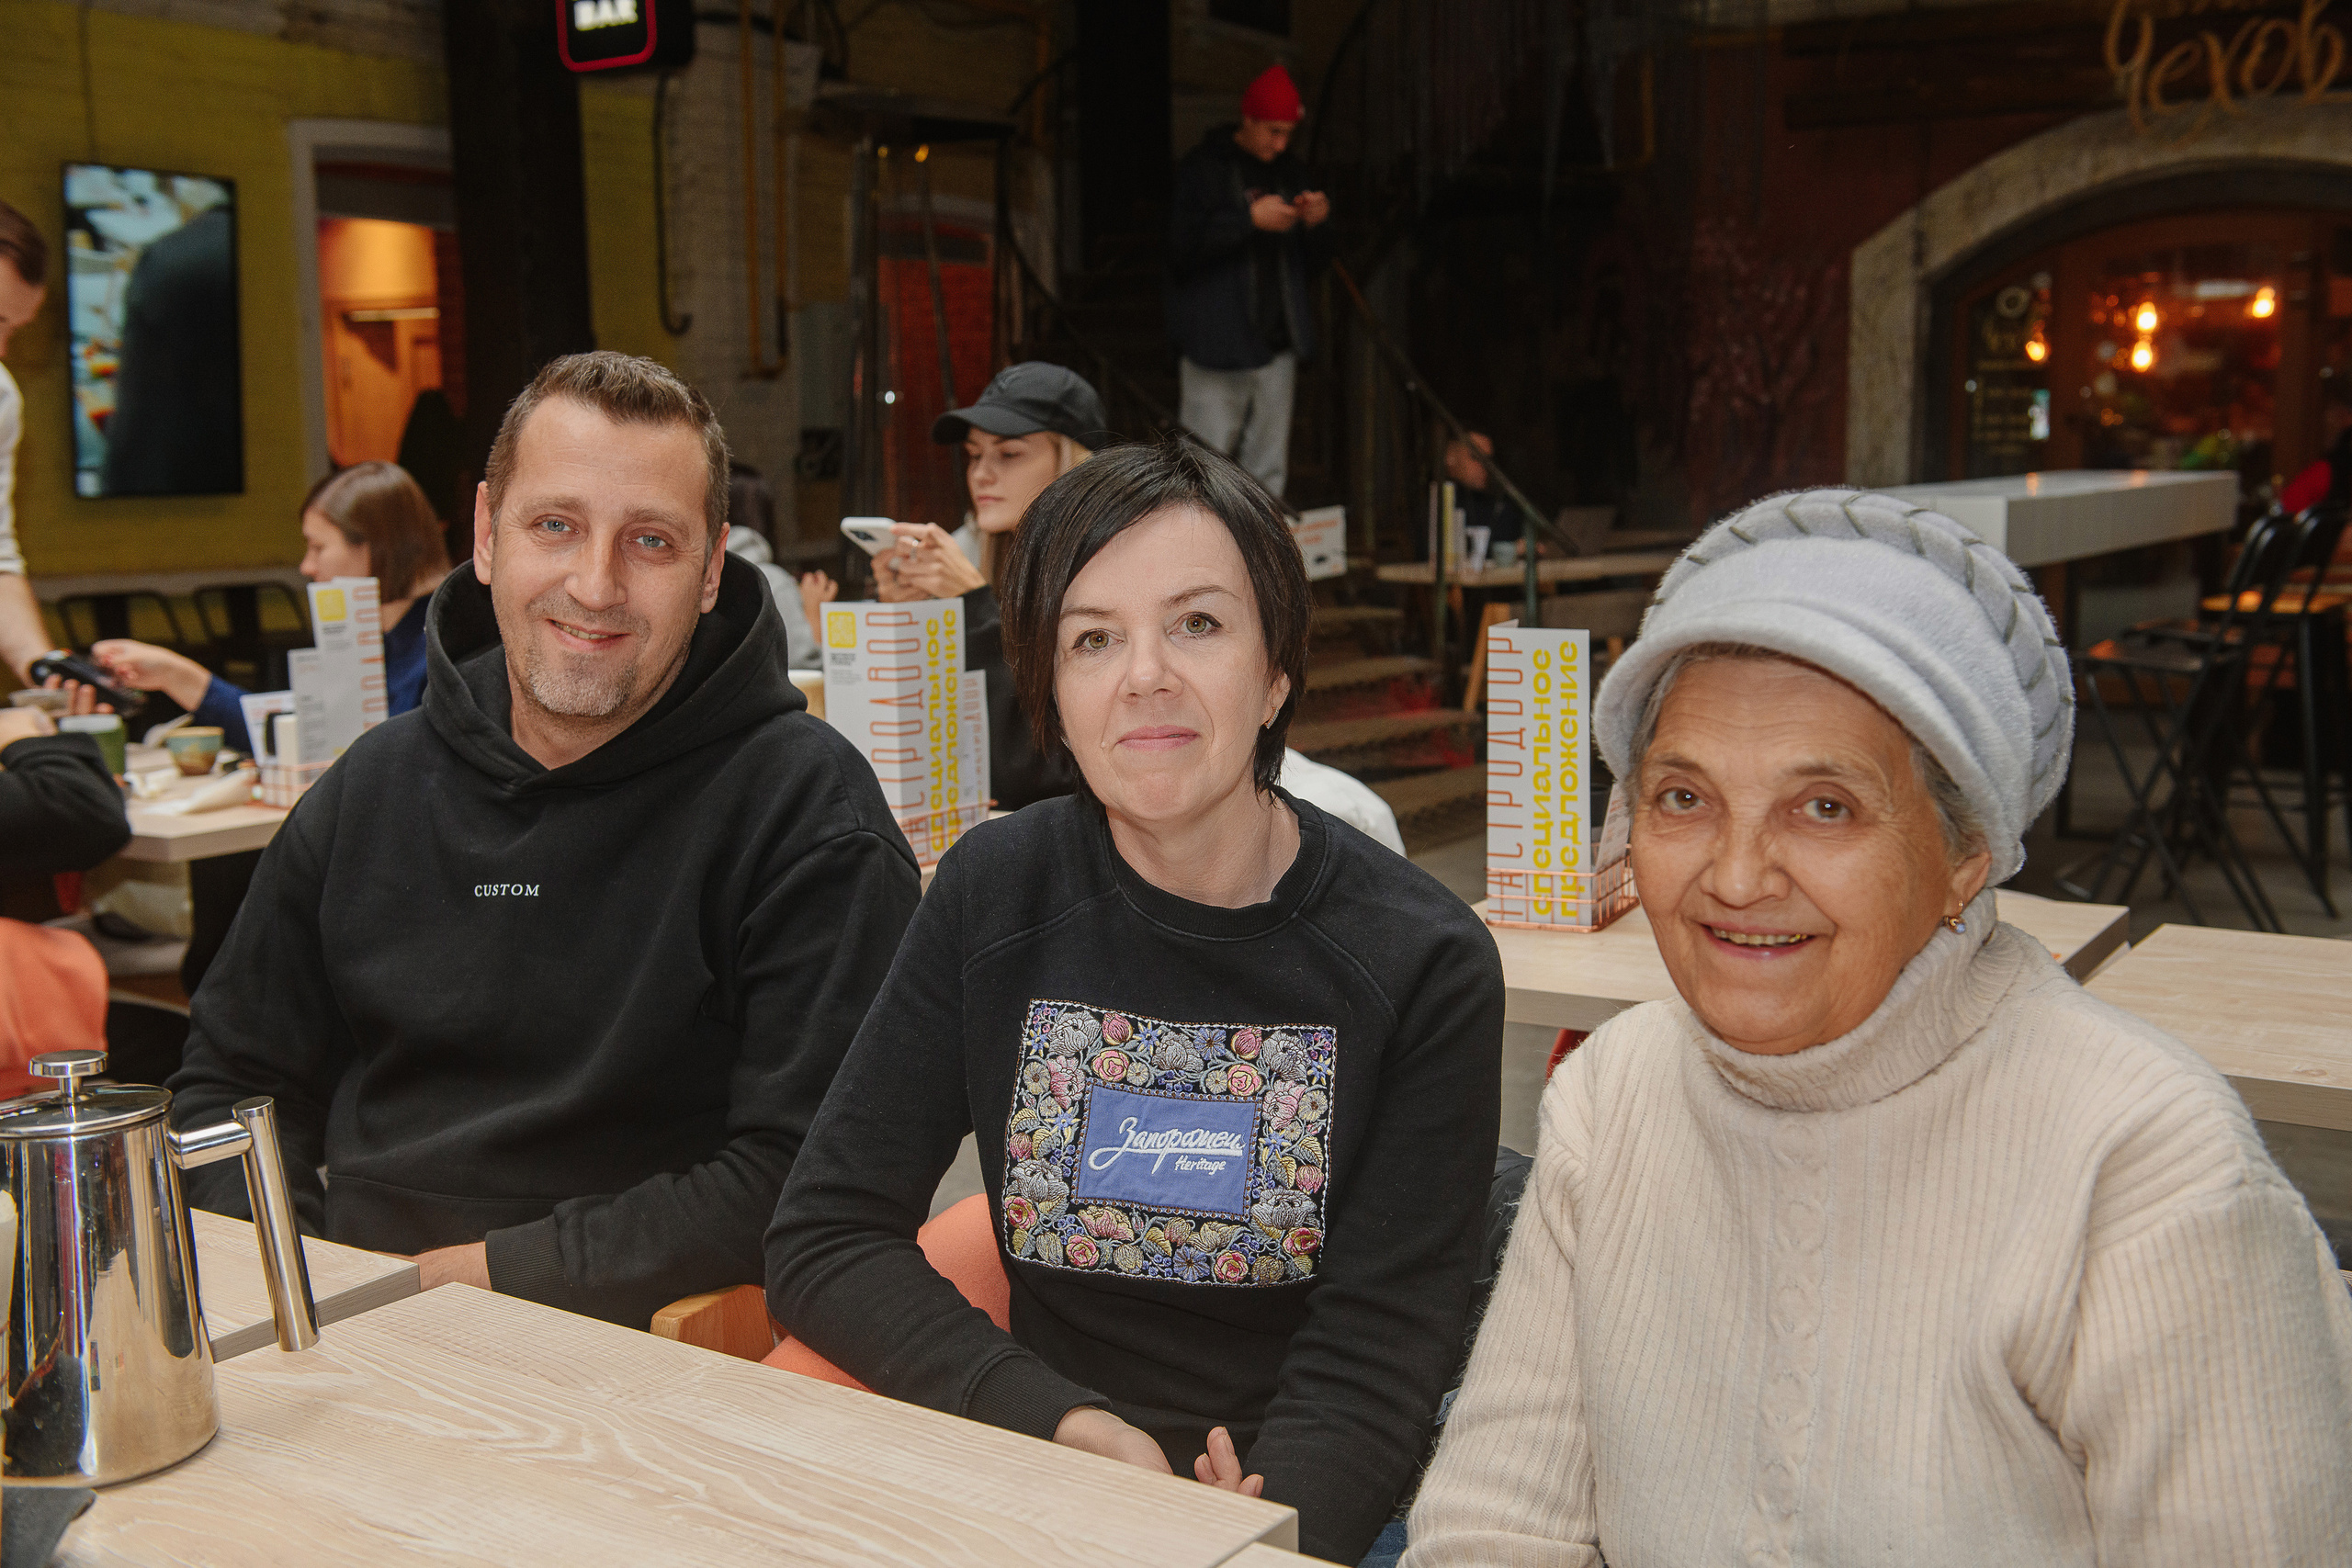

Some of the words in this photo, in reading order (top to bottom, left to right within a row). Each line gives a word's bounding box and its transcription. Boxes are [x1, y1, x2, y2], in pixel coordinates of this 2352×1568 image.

[1532, 648, 1555, 916] специальное
[1559, 640, 1585, 918] предложение
[474, 883, 540, 897] CUSTOM
[1174, 1155, 1227, 1176] Heritage
